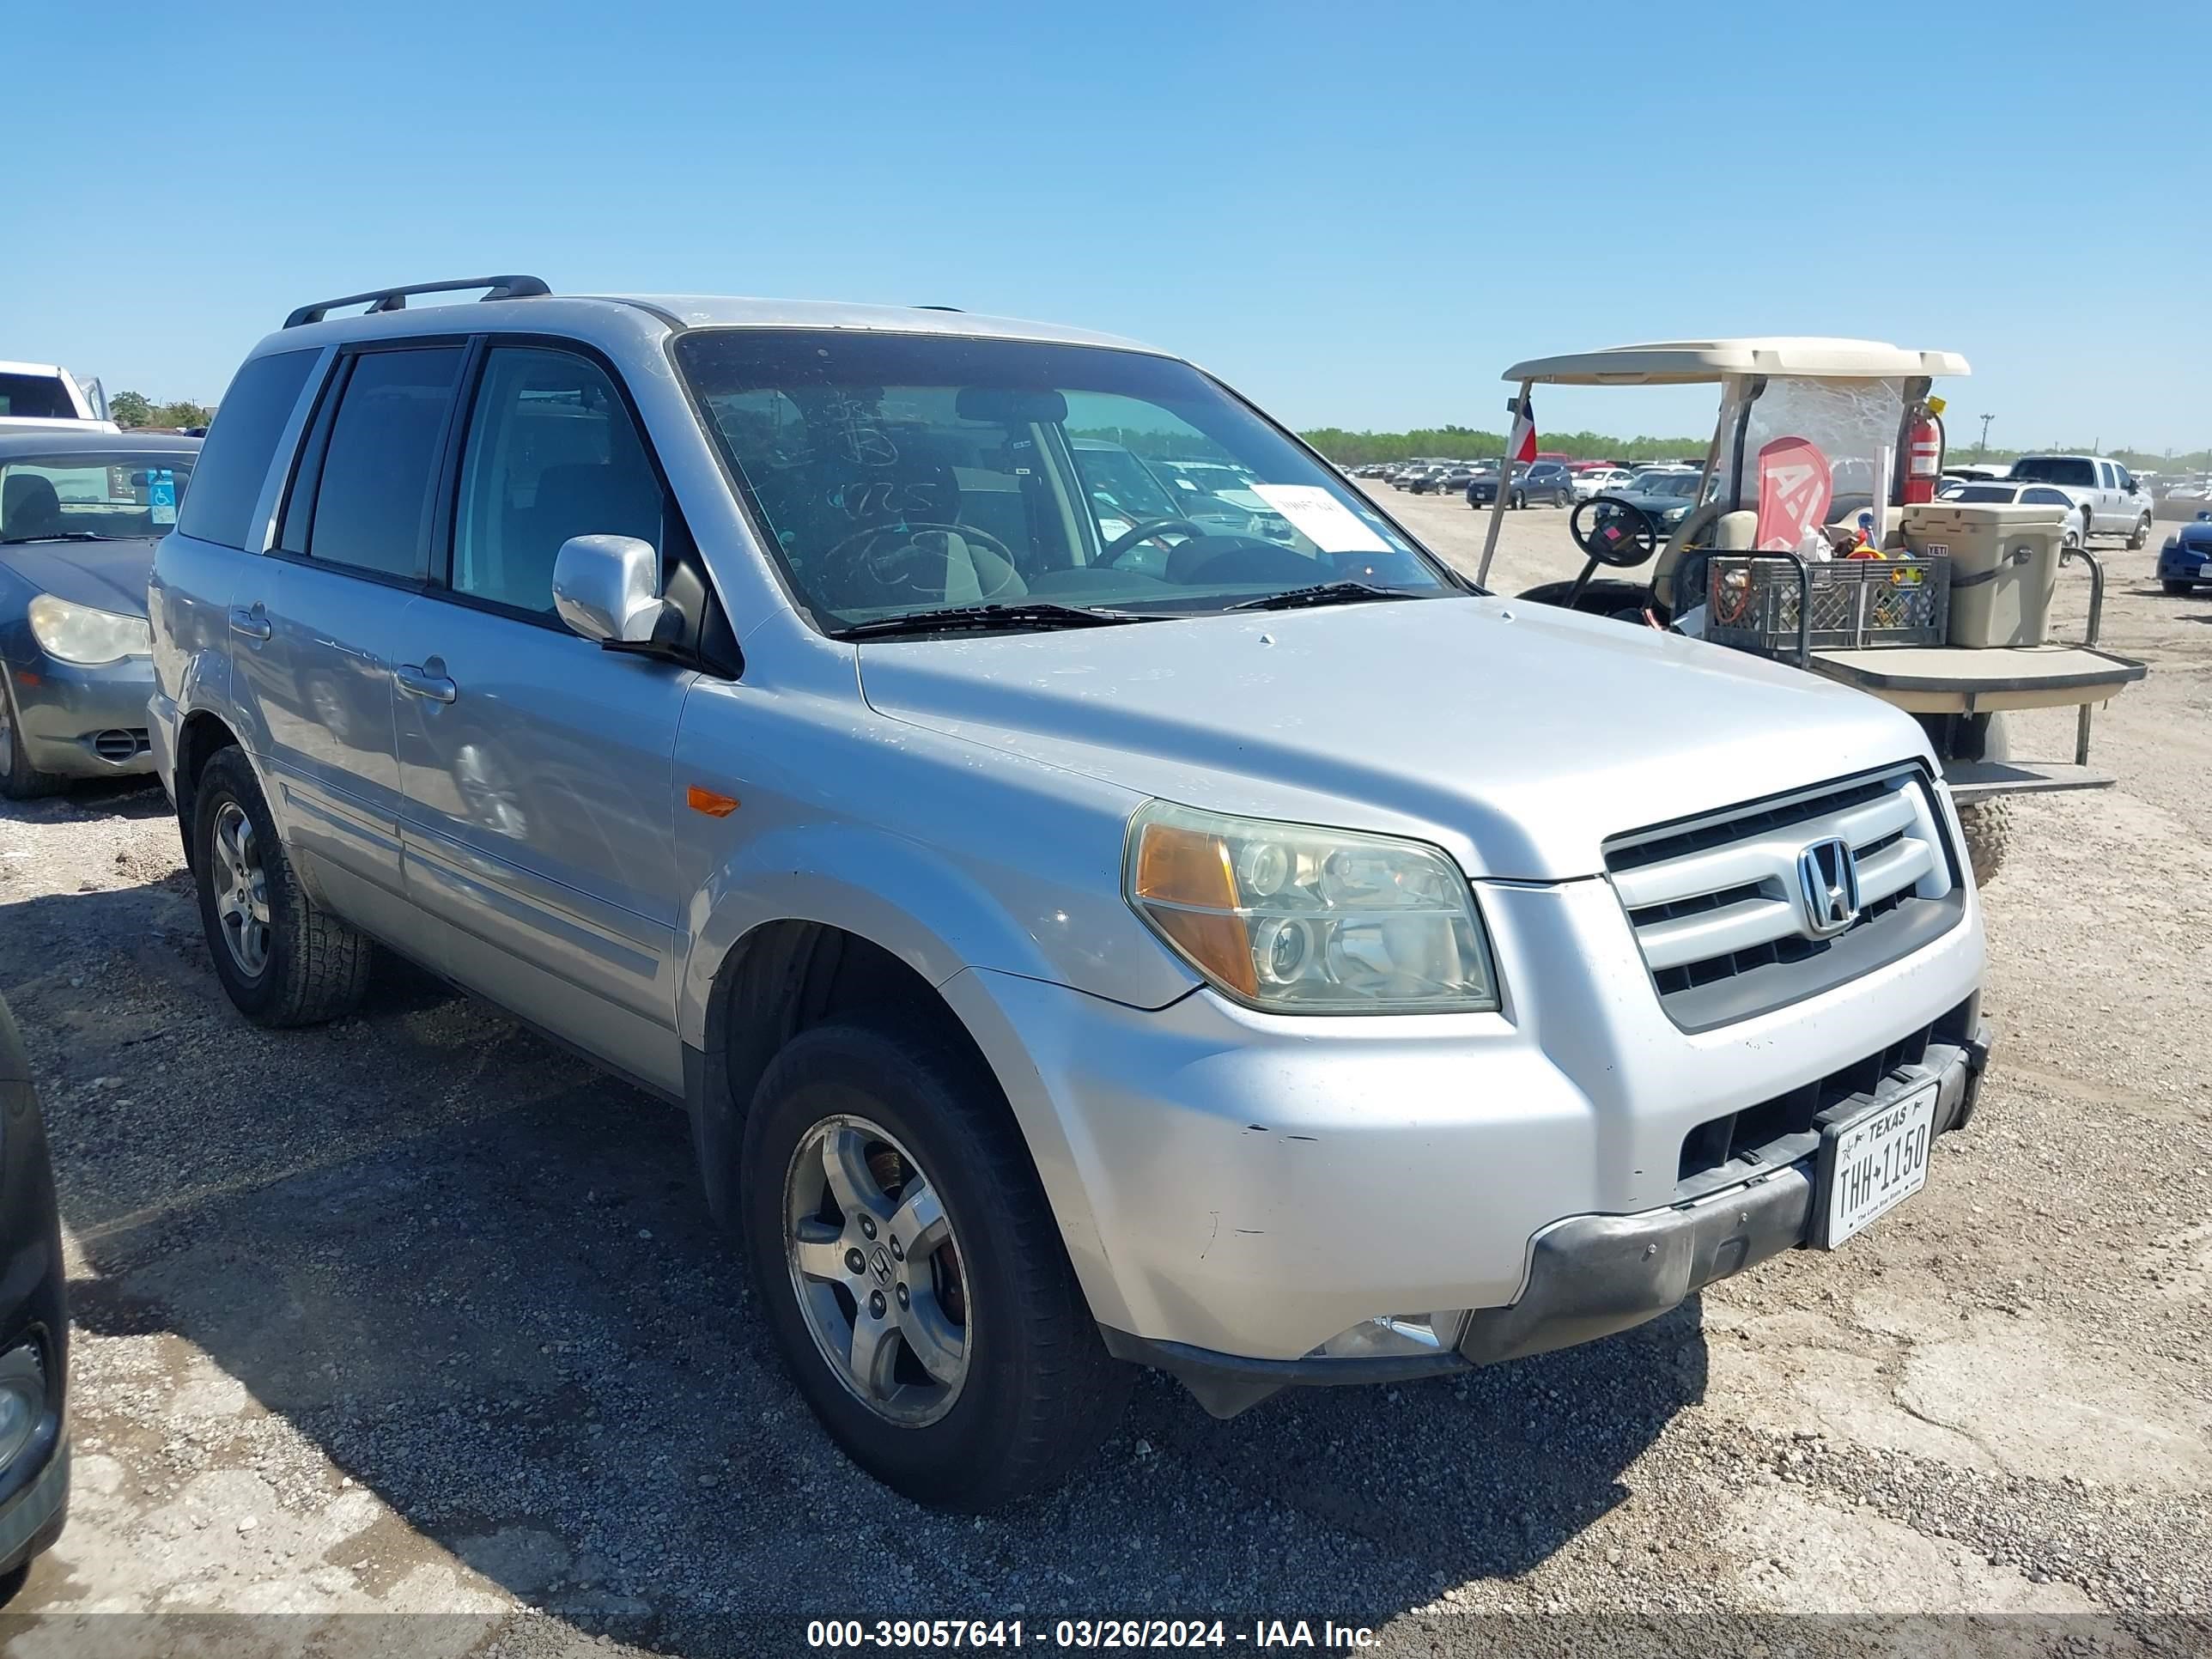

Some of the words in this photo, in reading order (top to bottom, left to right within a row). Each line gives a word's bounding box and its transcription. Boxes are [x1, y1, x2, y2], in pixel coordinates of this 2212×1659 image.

[1928, 545, 1948, 555] YETI
[1869, 1105, 1907, 1142] TEXAS
[1840, 1153, 1873, 1218] THH
[1881, 1123, 1926, 1192] 1150
